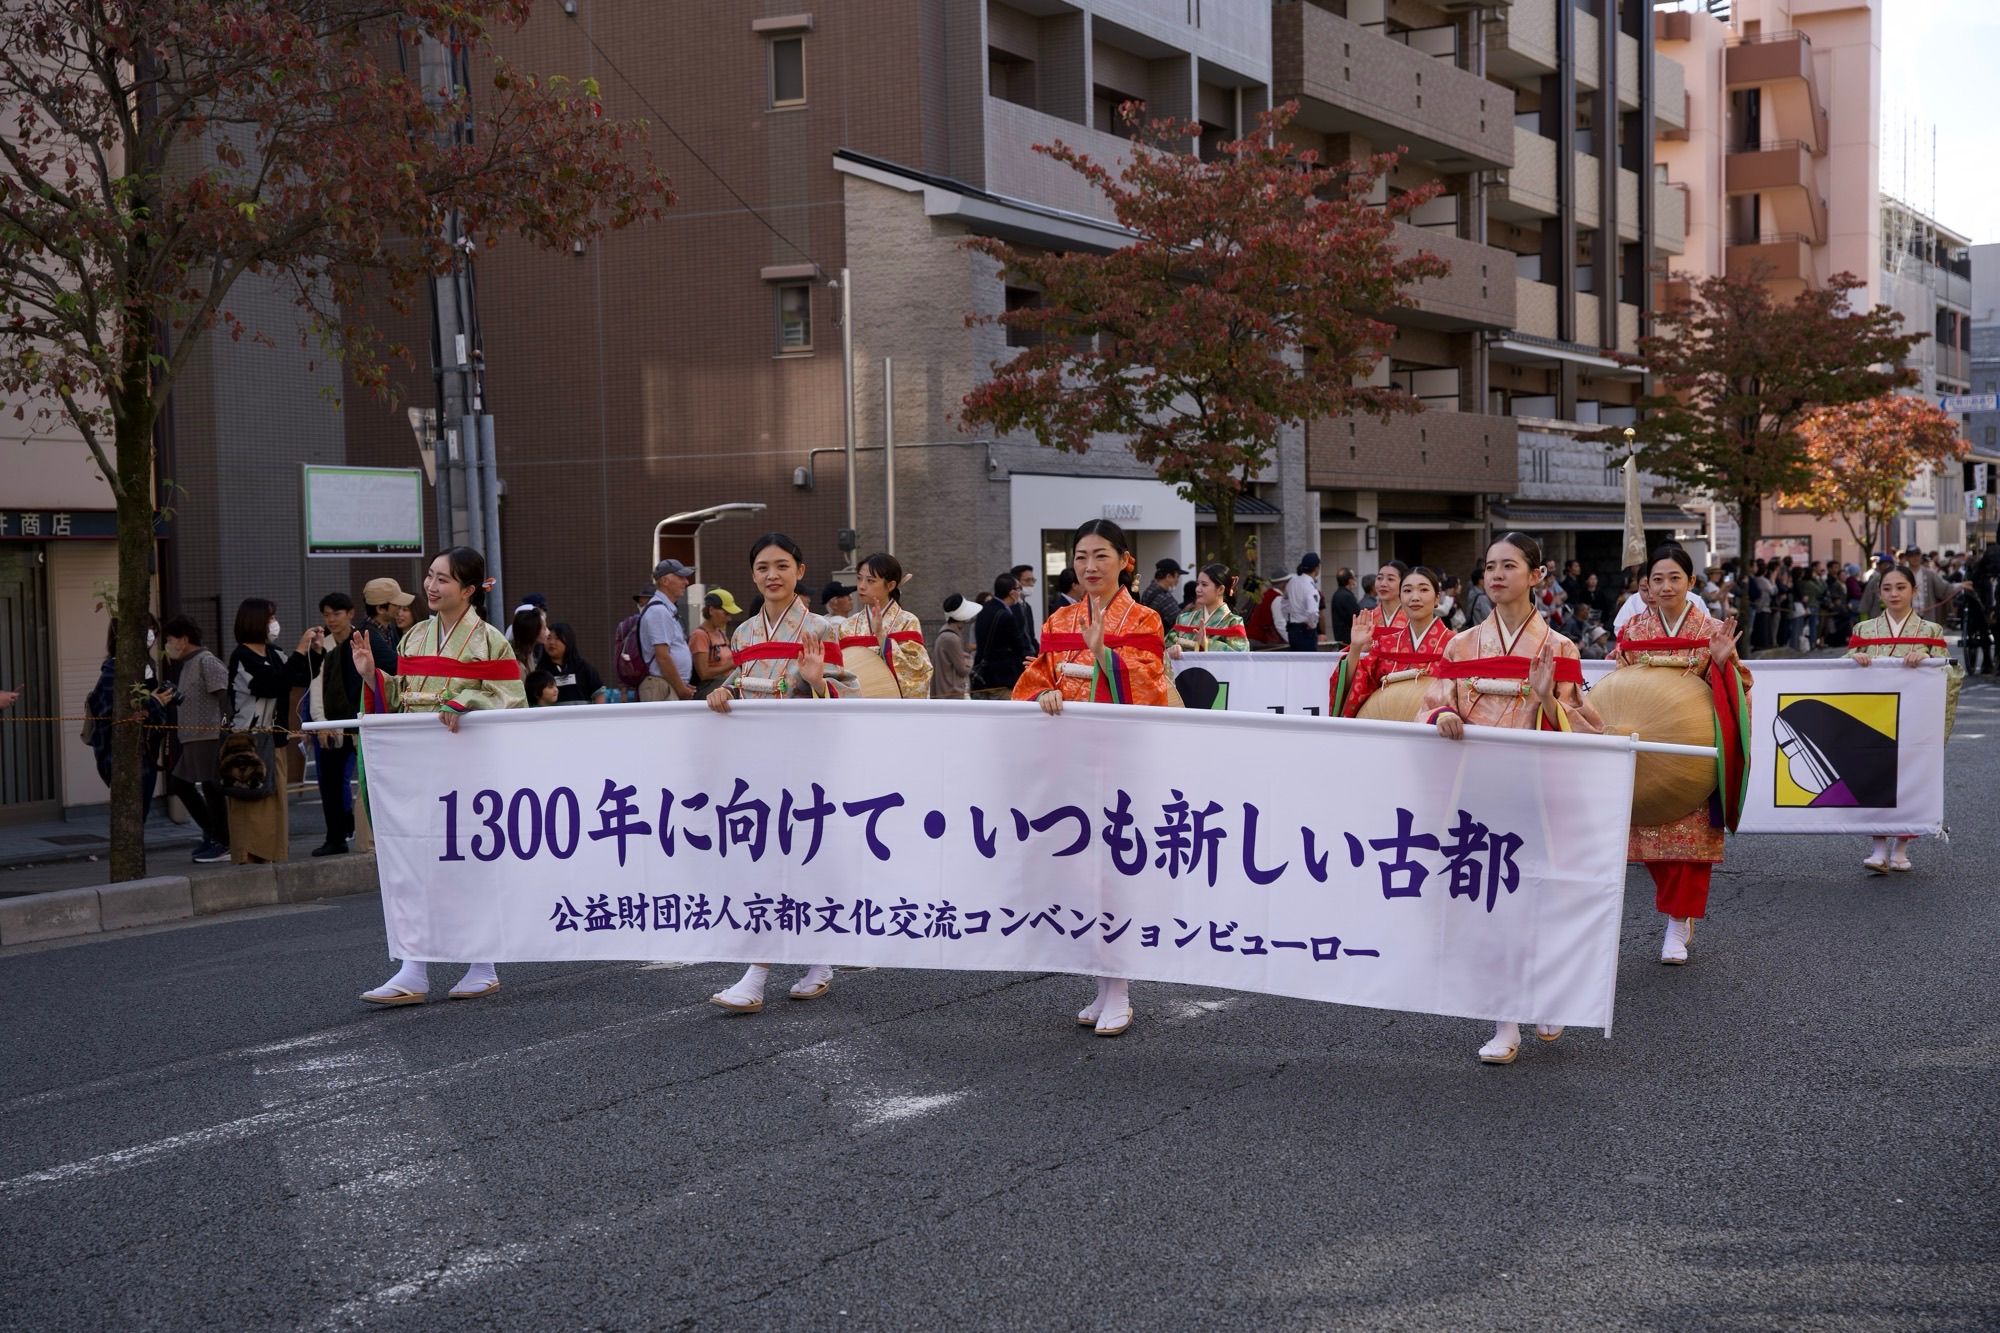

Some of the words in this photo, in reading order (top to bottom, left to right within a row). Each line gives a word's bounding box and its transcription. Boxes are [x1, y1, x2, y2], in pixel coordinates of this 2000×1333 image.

[438, 777, 1526, 914] 1300年に向けて・いつも新しい古都
[549, 891, 1382, 963] 公益財団法人京都文化交流コンベンションビューロー
